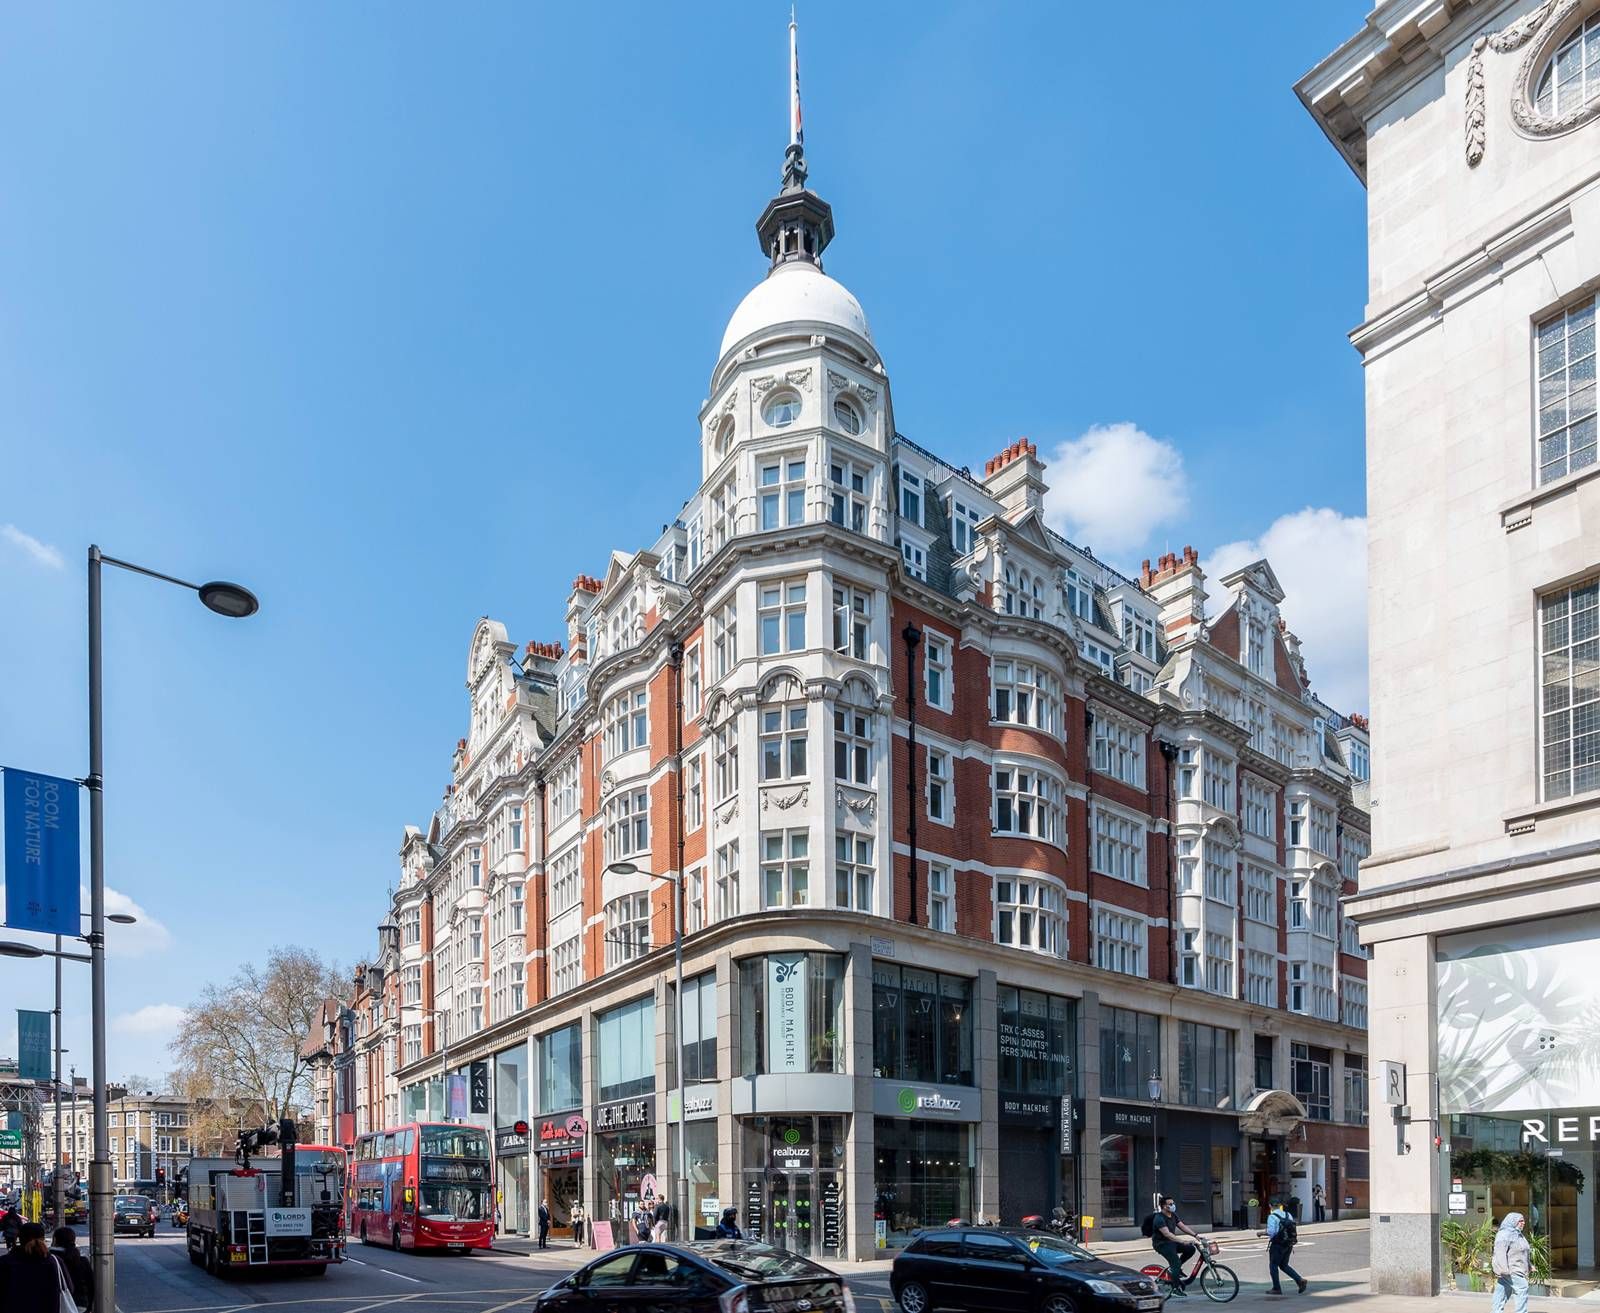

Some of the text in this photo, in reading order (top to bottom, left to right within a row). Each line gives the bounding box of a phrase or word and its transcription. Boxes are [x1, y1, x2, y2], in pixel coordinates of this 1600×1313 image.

[44, 781, 59, 829] ROOM
[25, 777, 41, 866] FOR NATURE
[785, 987, 795, 1066] BODY MACHINE
[1000, 1024, 1045, 1039] TRX CASSES
[1039, 1051, 1071, 1065] TRINING
[475, 1068, 485, 1109] ZARA
[684, 1096, 713, 1110] ealbuzz
[917, 1094, 961, 1111] realbuzz
[1004, 1101, 1020, 1110] BODY
[1022, 1103, 1049, 1113] MACHINE
[596, 1107, 608, 1127] JOE
[612, 1105, 624, 1125] THE
[625, 1101, 646, 1124] JUICE
[1115, 1112, 1128, 1121] BODY
[1129, 1114, 1152, 1124] MACHINE
[503, 1135, 526, 1147] ZARA
[773, 1147, 810, 1157] realbuzz
[471, 1167, 482, 1177] 49
[282, 1213, 307, 1221] LORDS
